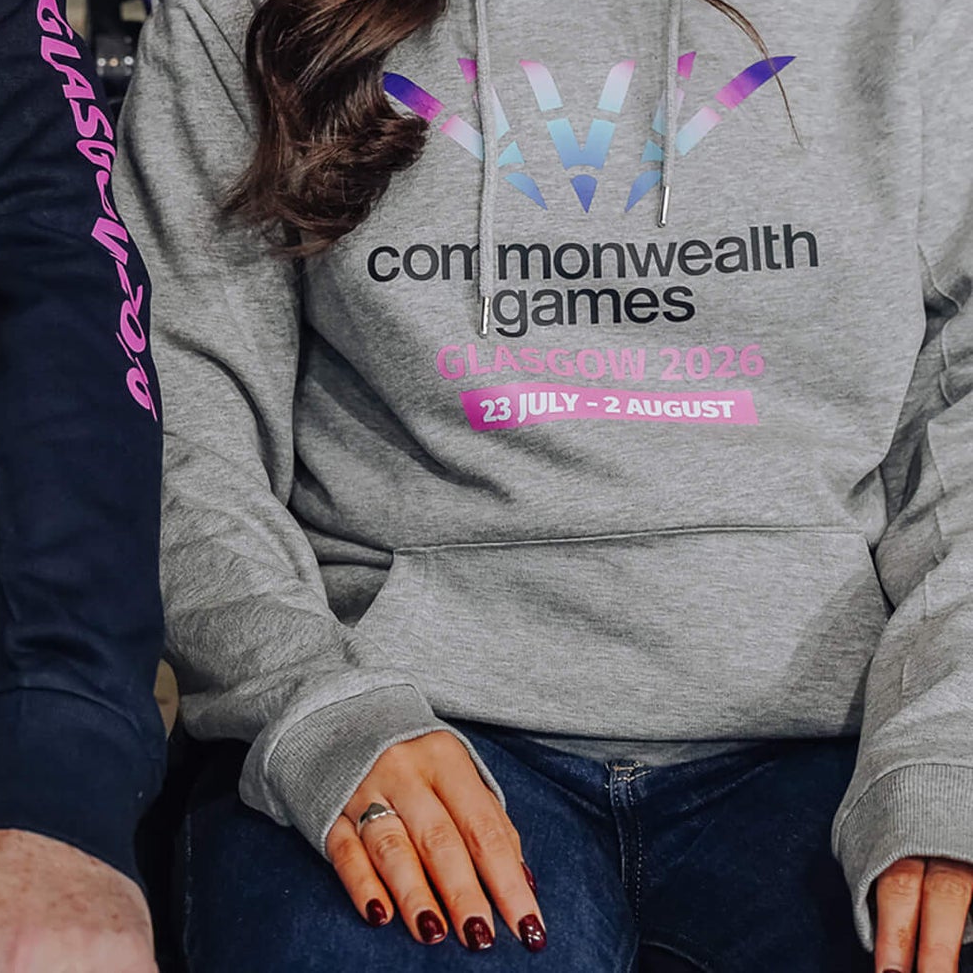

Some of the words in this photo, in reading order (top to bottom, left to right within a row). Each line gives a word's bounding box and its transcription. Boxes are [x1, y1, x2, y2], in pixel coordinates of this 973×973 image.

[367, 224, 819, 283] commonwealth
[492, 285, 696, 338] games
[115, 259, 157, 422] 206
[436, 343, 646, 382] GLASGOW
[658, 343, 766, 381] 2026
[480, 396, 512, 423] 23
[517, 391, 580, 423] JULY
[603, 396, 621, 414] 2
[626, 398, 736, 419] AUGUST
